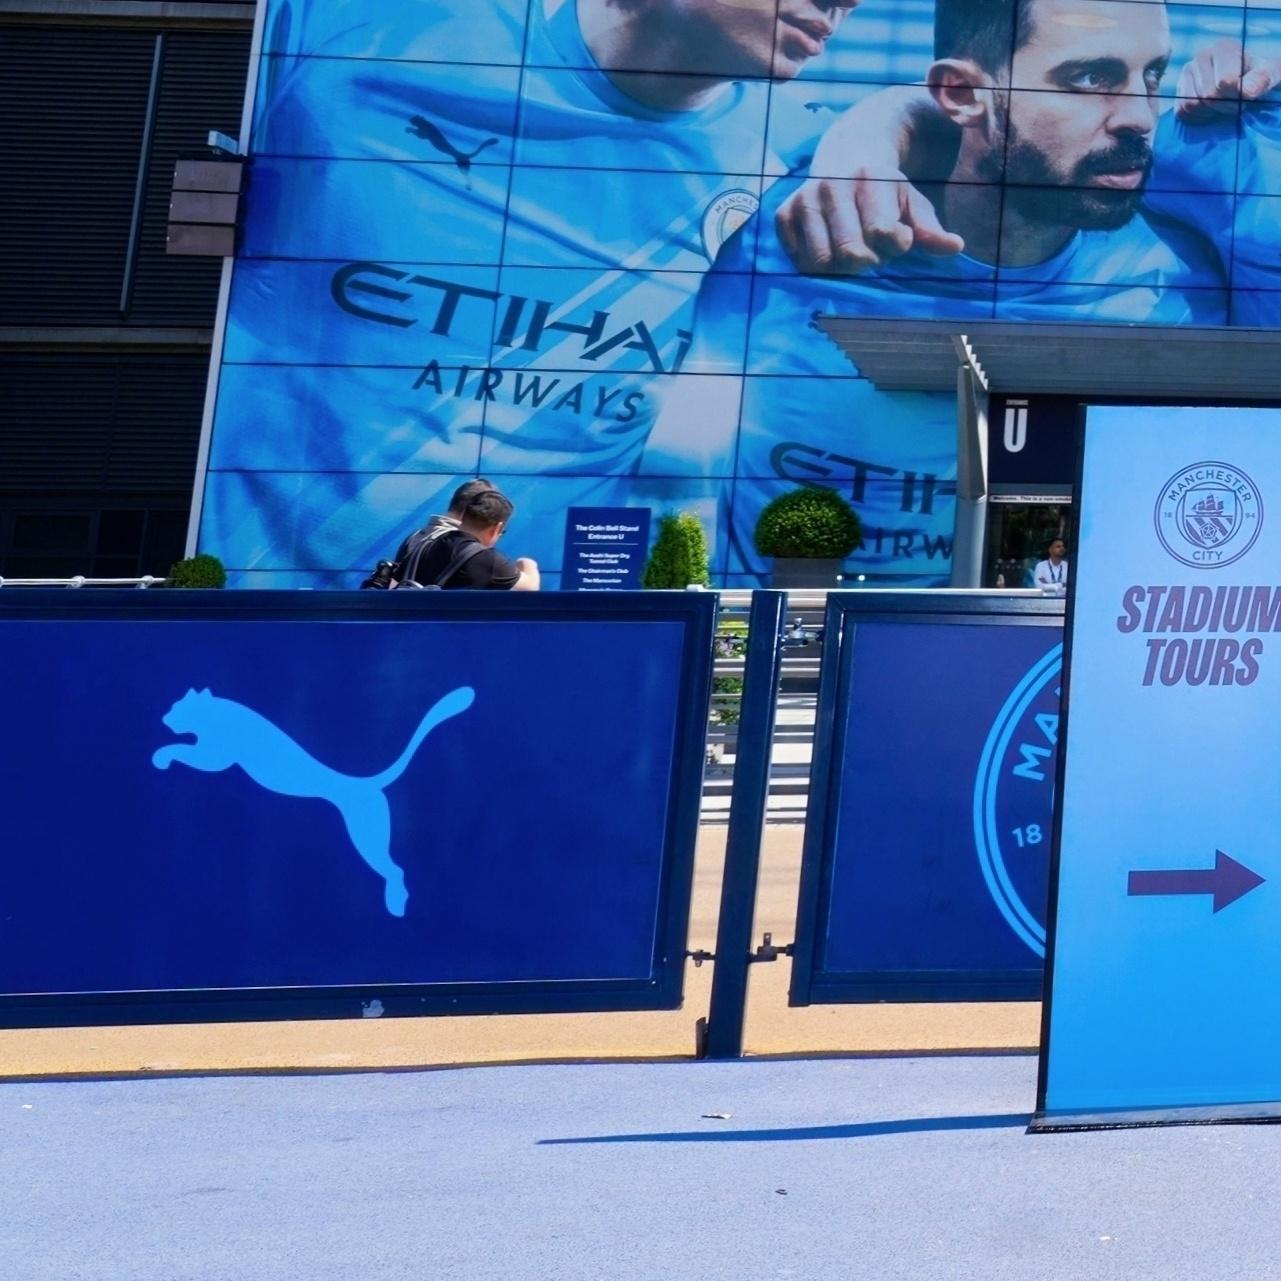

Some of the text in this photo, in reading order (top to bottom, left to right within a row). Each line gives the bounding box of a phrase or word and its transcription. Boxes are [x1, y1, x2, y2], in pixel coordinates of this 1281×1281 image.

[412, 357, 648, 423] AIRWAYS
[1003, 408, 1027, 453] U
[1168, 470, 1252, 502] MANCHESTER
[1192, 550, 1223, 561] CITY
[1141, 638, 1264, 687] TOURS
[1012, 824, 1042, 848] 18
